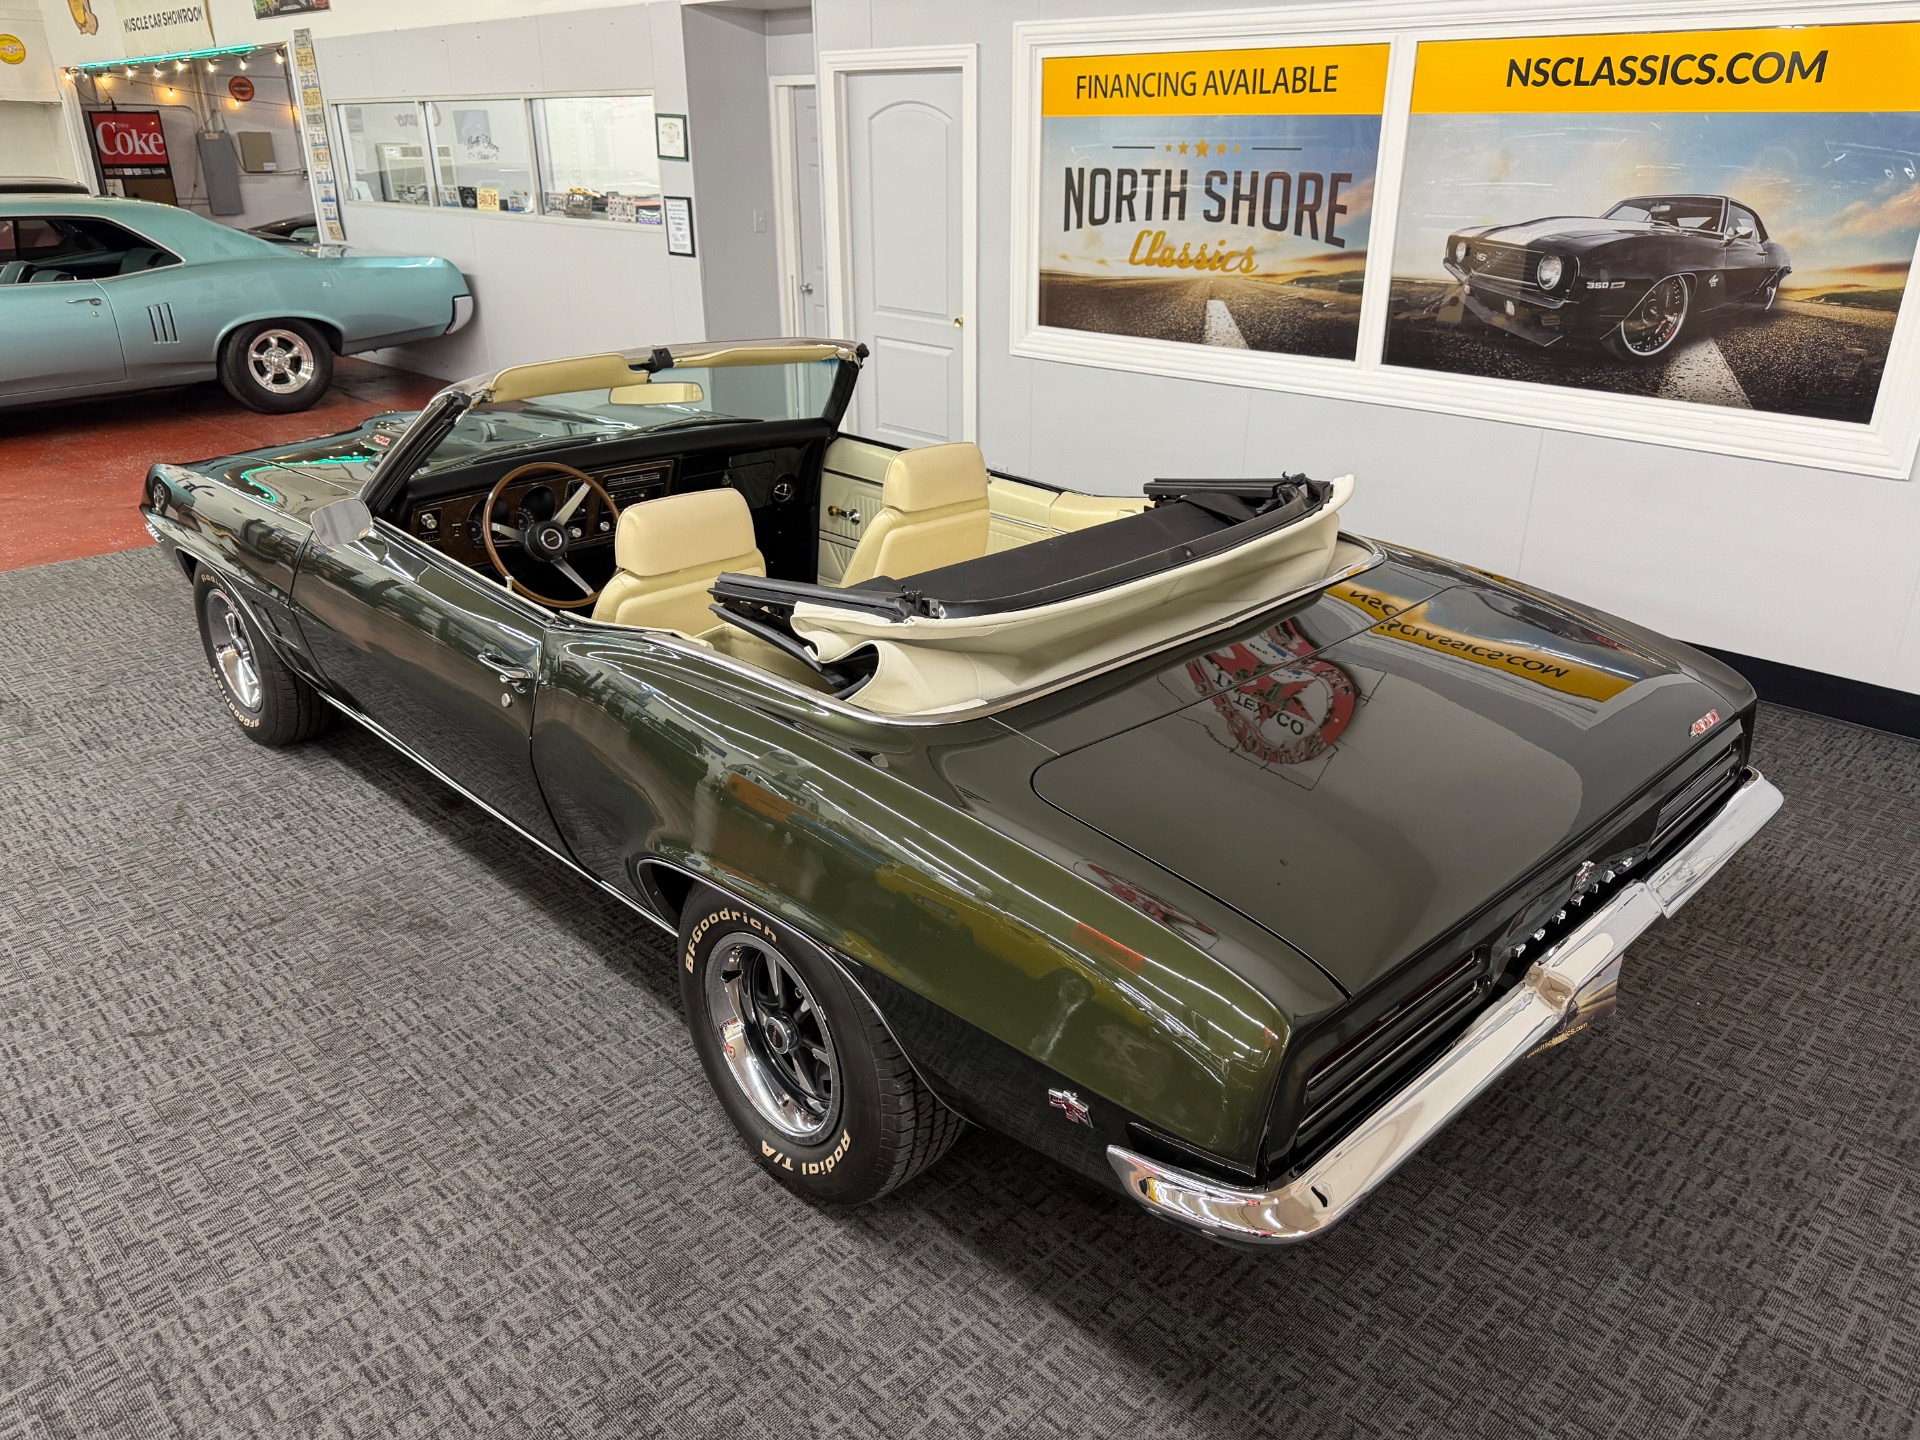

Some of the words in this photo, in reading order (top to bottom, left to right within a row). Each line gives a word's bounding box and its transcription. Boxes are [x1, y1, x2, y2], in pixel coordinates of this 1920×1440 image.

[123, 16, 149, 33] MUSCLE
[148, 13, 162, 29] CAR
[162, 5, 203, 26] SHOWROOM
[1075, 71, 1197, 100] FINANCING
[1203, 64, 1339, 96] AVAILABLE
[1506, 49, 1829, 88] NSCLASSICS.COM
[95, 121, 166, 156] Coke
[1063, 167, 1188, 232] NORTH
[1203, 170, 1352, 249] SHORE
[1128, 229, 1259, 274] Classics
[1586, 281, 1609, 289] 350
[1692, 708, 1720, 735] 400
[684, 907, 778, 974] BFGoodrich
[760, 1139, 794, 1172] T/A
[801, 1128, 852, 1176] Radial
